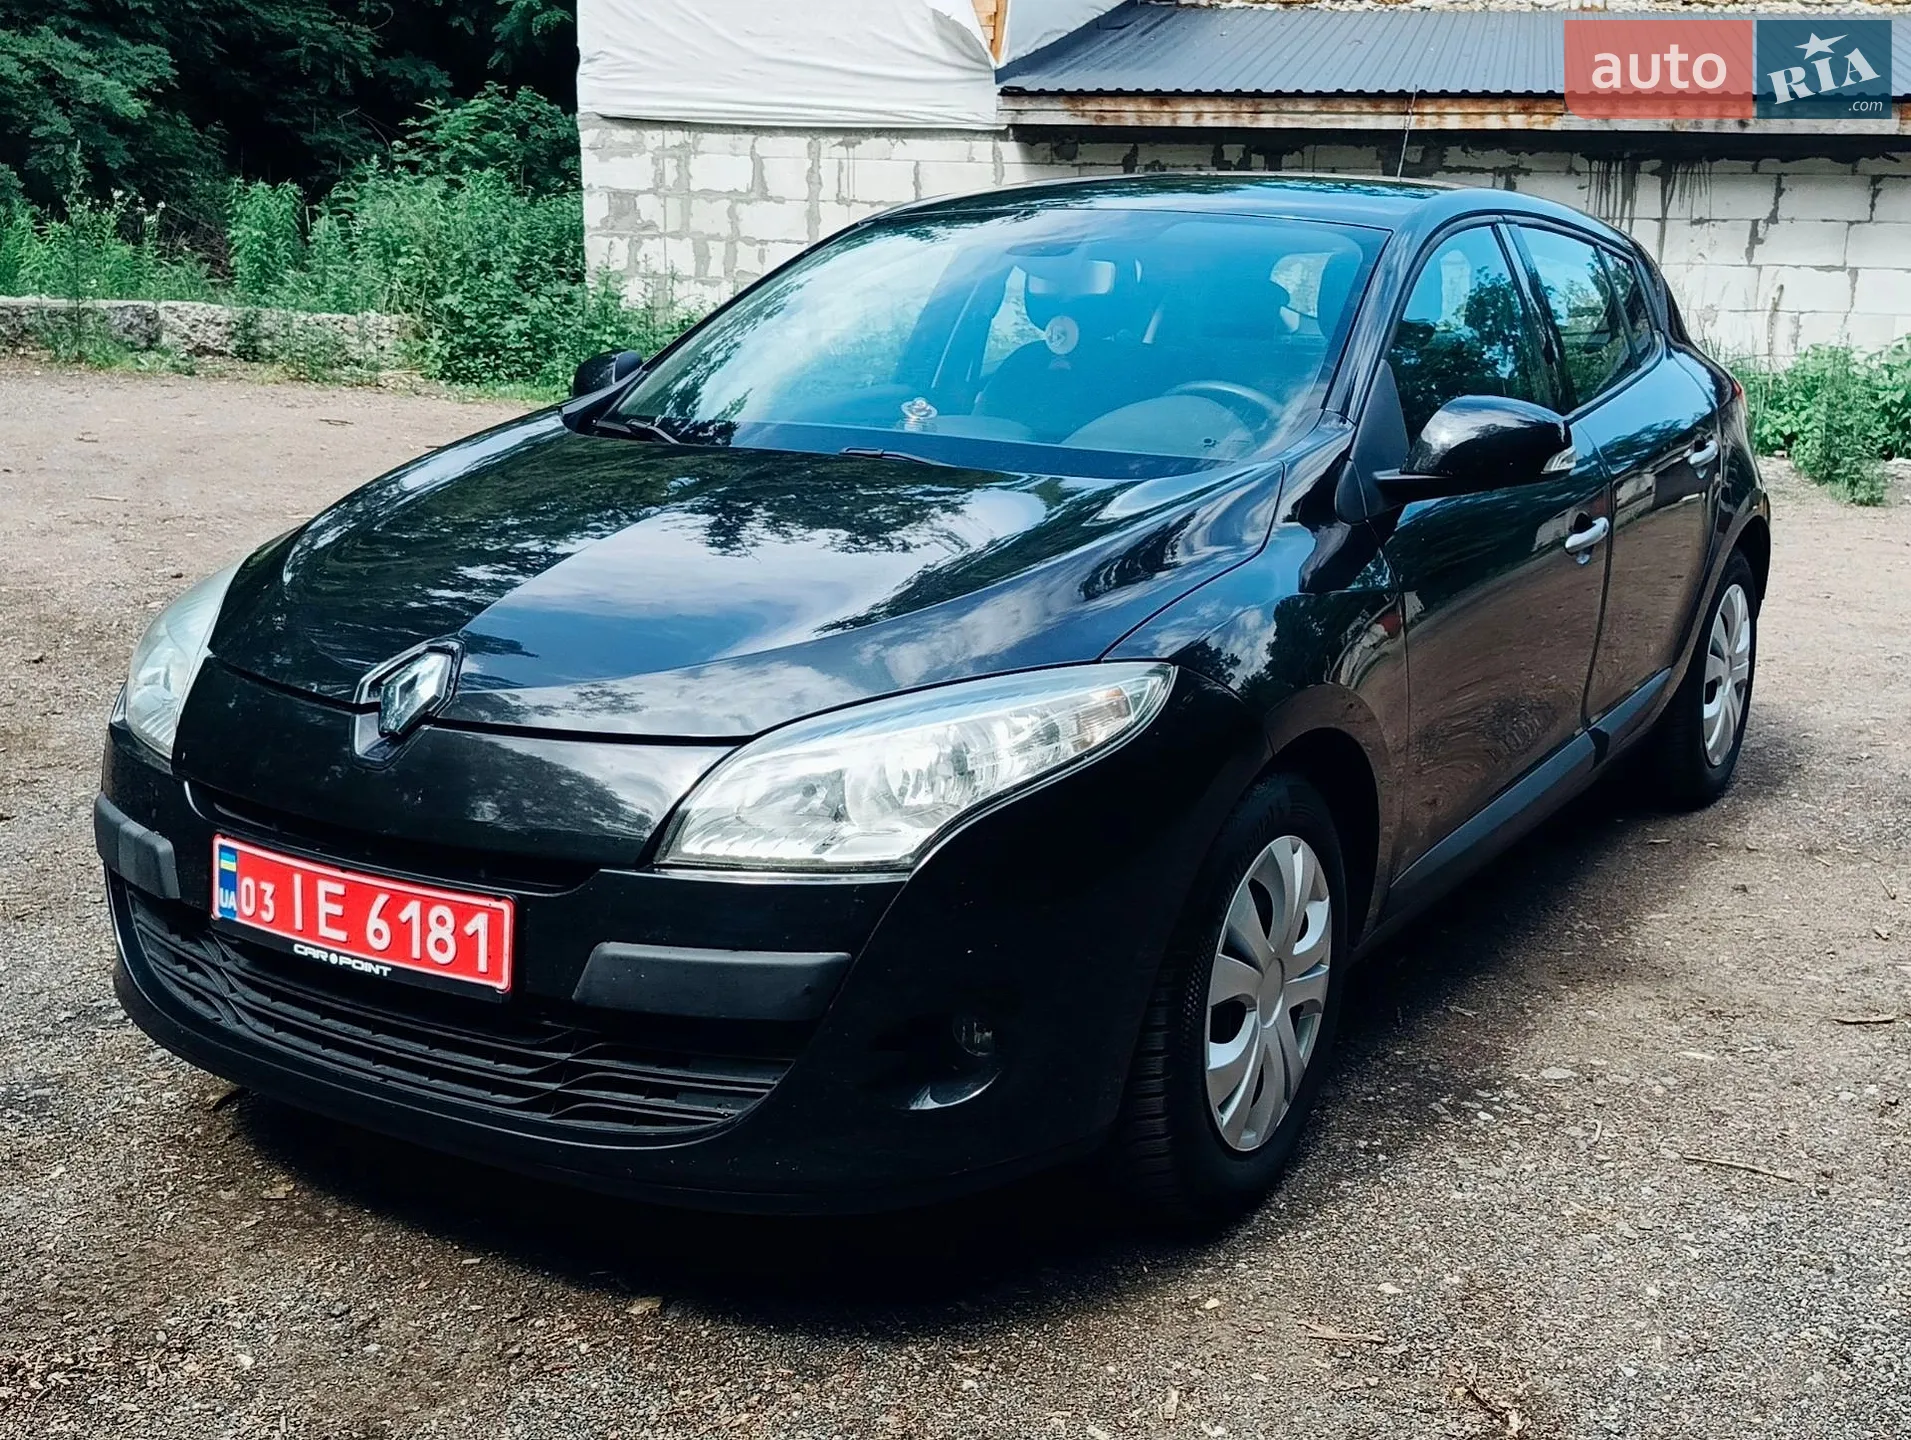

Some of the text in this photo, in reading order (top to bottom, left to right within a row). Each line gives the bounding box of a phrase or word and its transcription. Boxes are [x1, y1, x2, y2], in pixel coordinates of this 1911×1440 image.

[219, 889, 237, 912] UA
[241, 873, 489, 973] 03 IE 6181
[293, 943, 392, 977] CAR POINT
